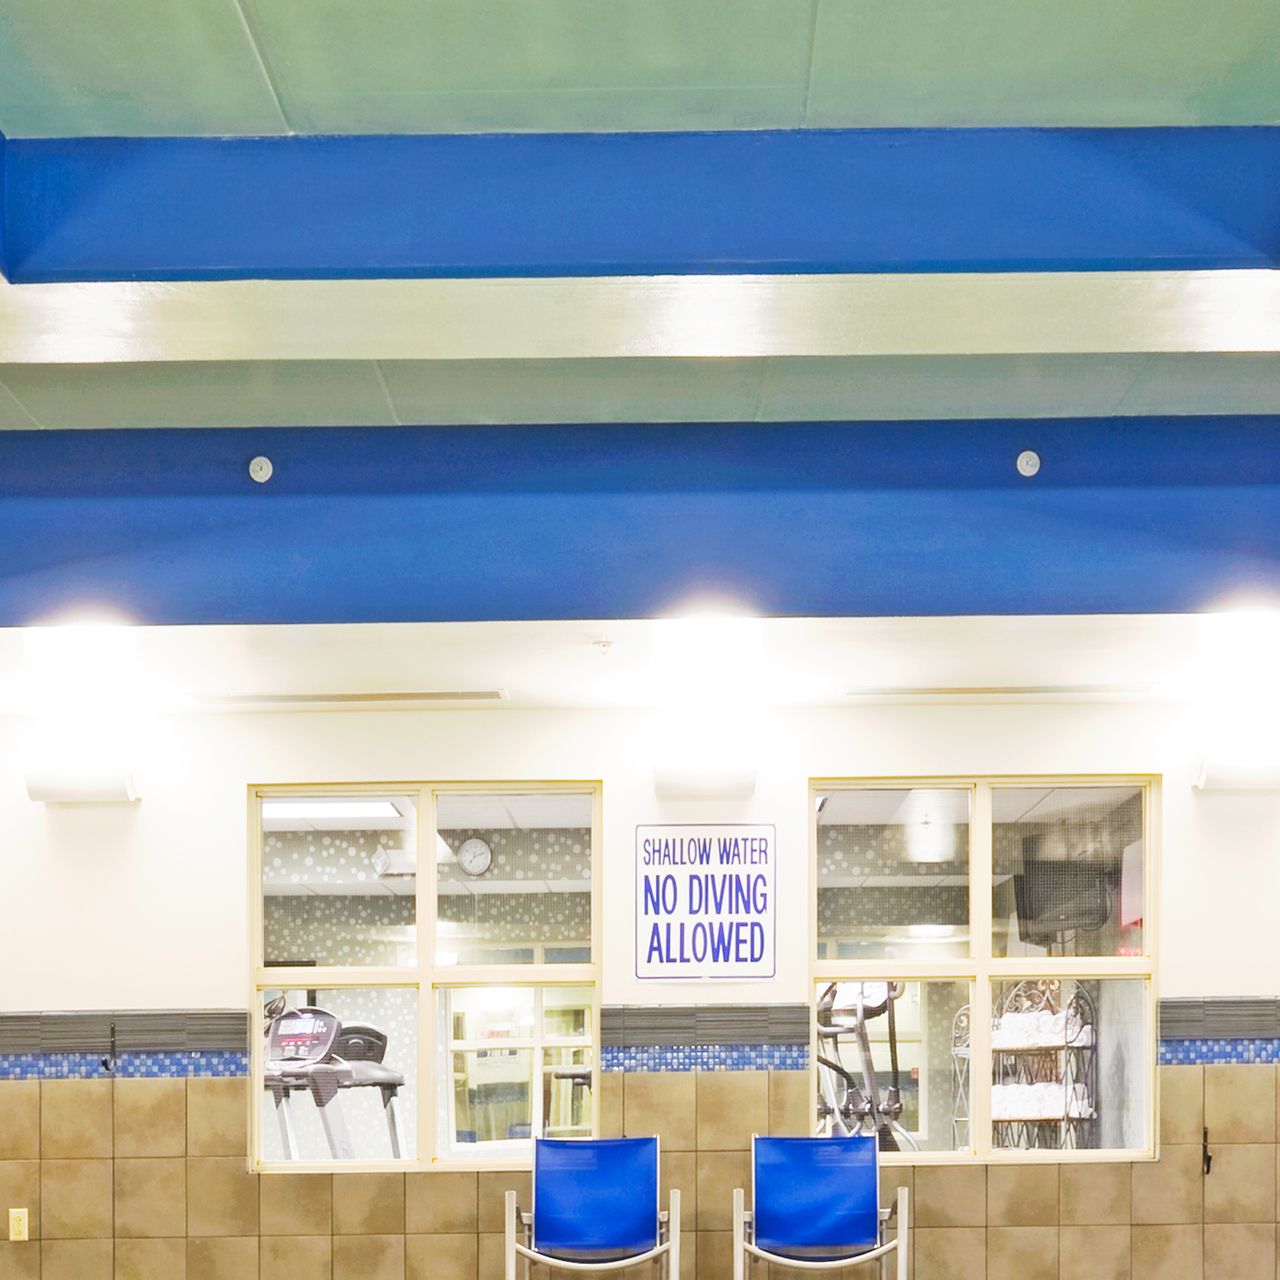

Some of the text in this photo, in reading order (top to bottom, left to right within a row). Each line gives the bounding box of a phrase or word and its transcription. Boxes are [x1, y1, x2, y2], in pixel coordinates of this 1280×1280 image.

[643, 837, 768, 866] SHALLOW WATER
[644, 873, 768, 915] NO DIVING
[646, 921, 765, 964] ALLOWED
